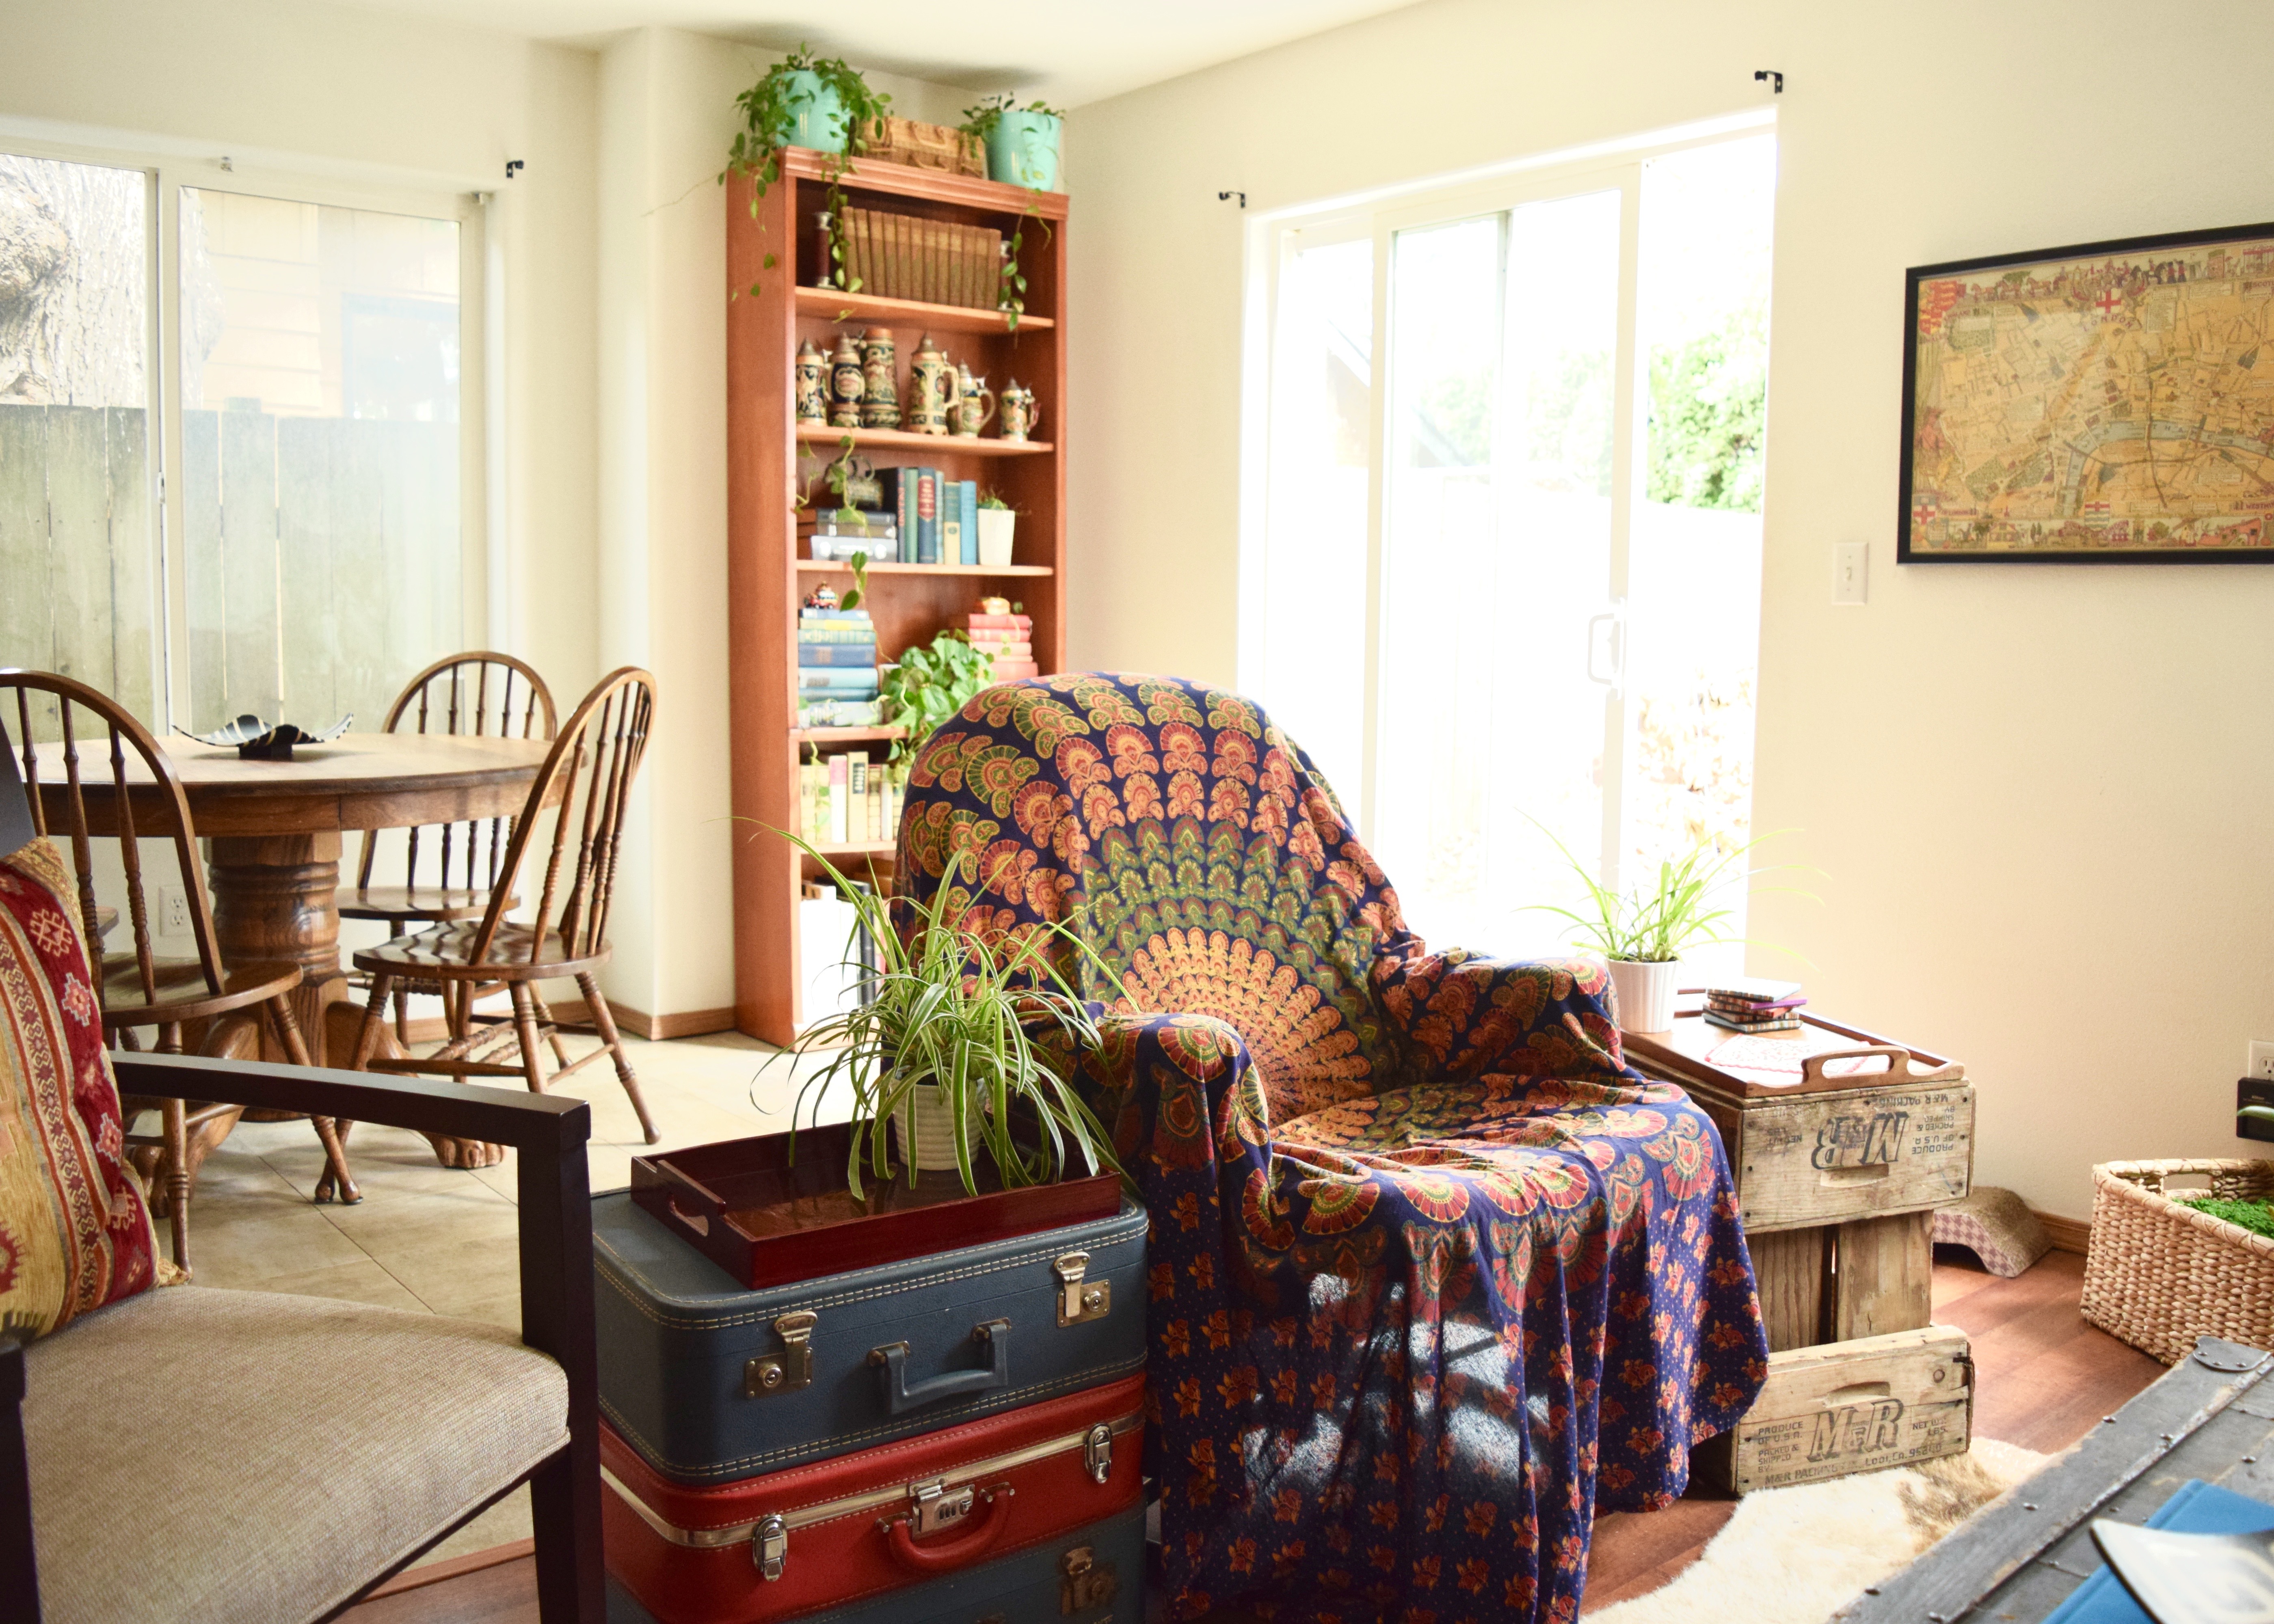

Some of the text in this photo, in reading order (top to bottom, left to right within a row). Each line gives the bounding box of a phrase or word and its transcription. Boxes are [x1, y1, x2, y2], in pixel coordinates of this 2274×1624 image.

[2082, 314, 2132, 332] LONDON
[1925, 1122, 1954, 1130] PACKED
[1943, 1134, 1954, 1142] OF
[1912, 1143, 1954, 1155] PRODUCE
[1758, 1421, 1803, 1435] PRODUCE
[1913, 1421, 1927, 1430] NET
[1792, 1444, 1799, 1452] &
